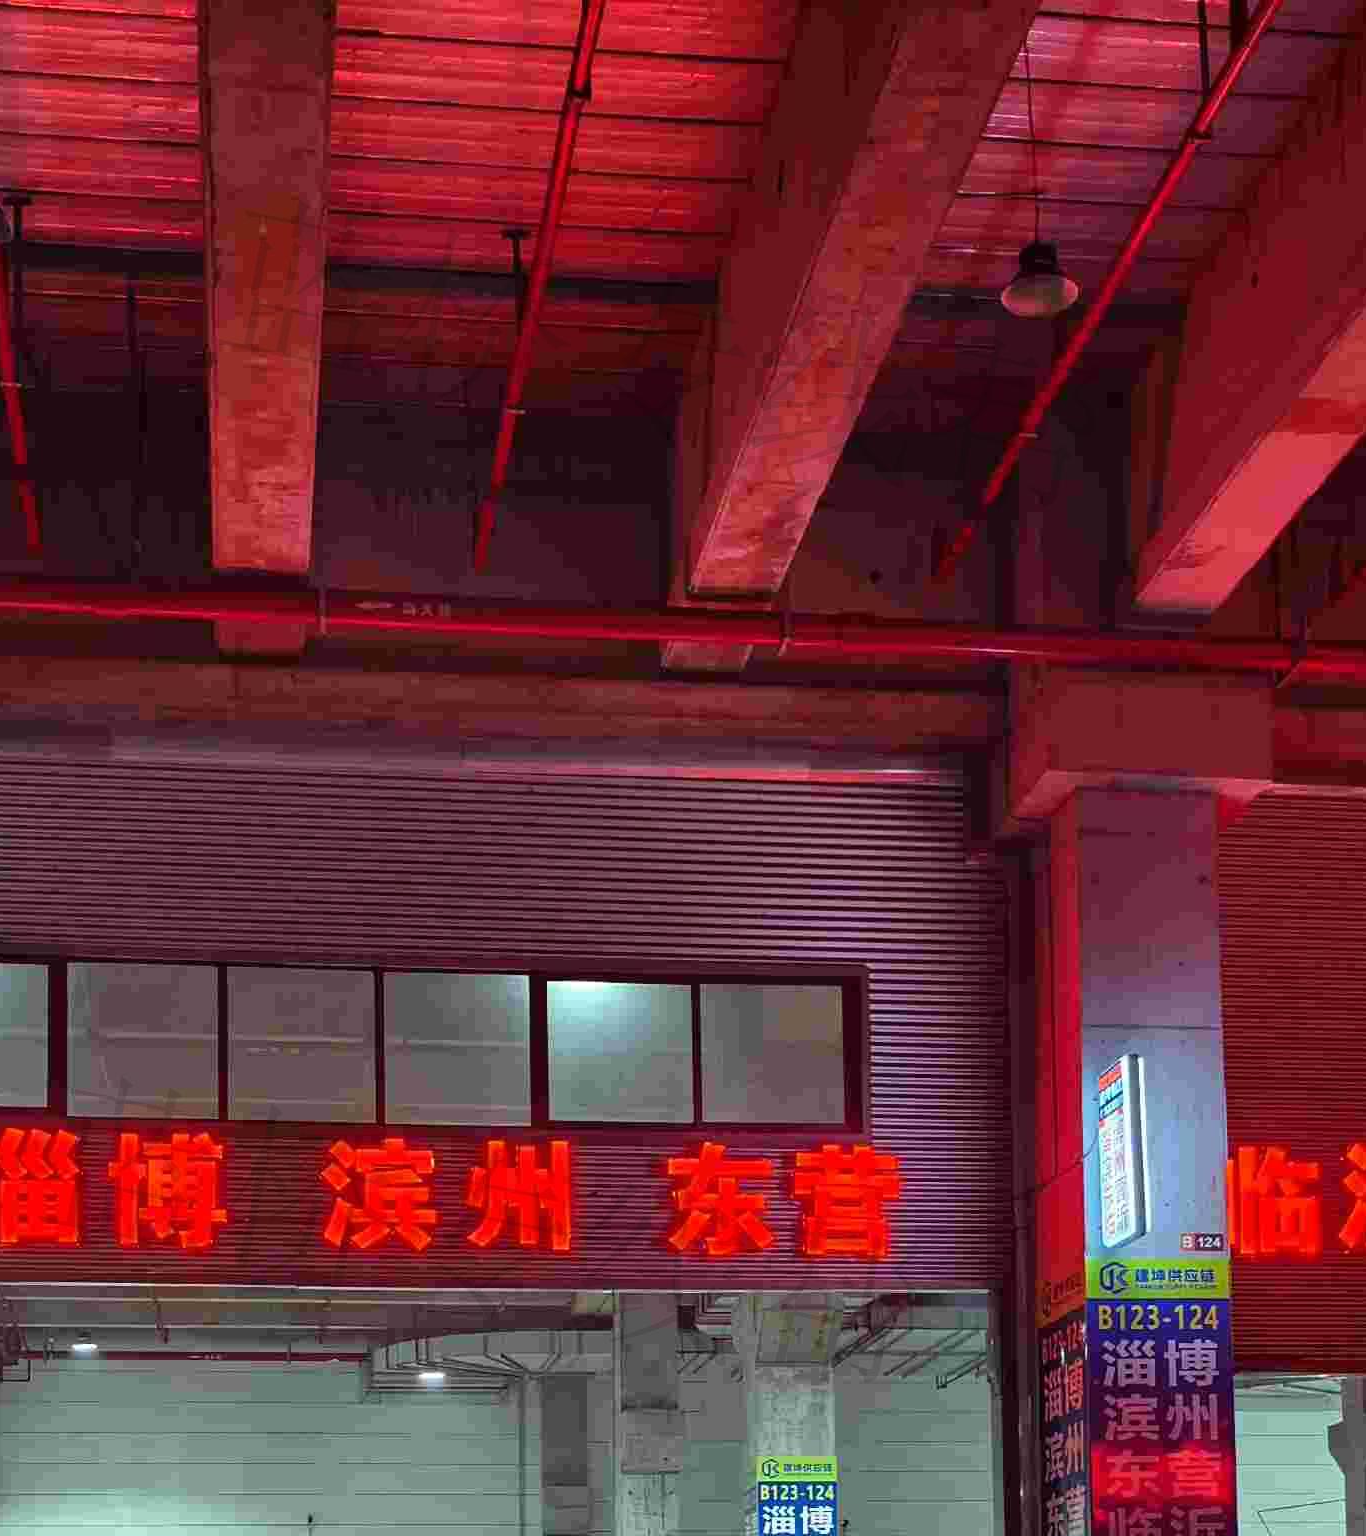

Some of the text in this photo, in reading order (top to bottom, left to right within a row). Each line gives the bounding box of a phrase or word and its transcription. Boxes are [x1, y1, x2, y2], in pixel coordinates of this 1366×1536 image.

[321, 1137, 575, 1253] 滨州
[665, 1140, 905, 1260] 东营
[1197, 1236, 1222, 1248] 124
[1098, 1304, 1219, 1330] B123-124
[1102, 1338, 1220, 1387] 淄博
[1102, 1394, 1221, 1442] 滨州
[760, 1485, 834, 1501] B123-124
[1107, 1449, 1223, 1499] 东营
[762, 1506, 835, 1535] 淄博
